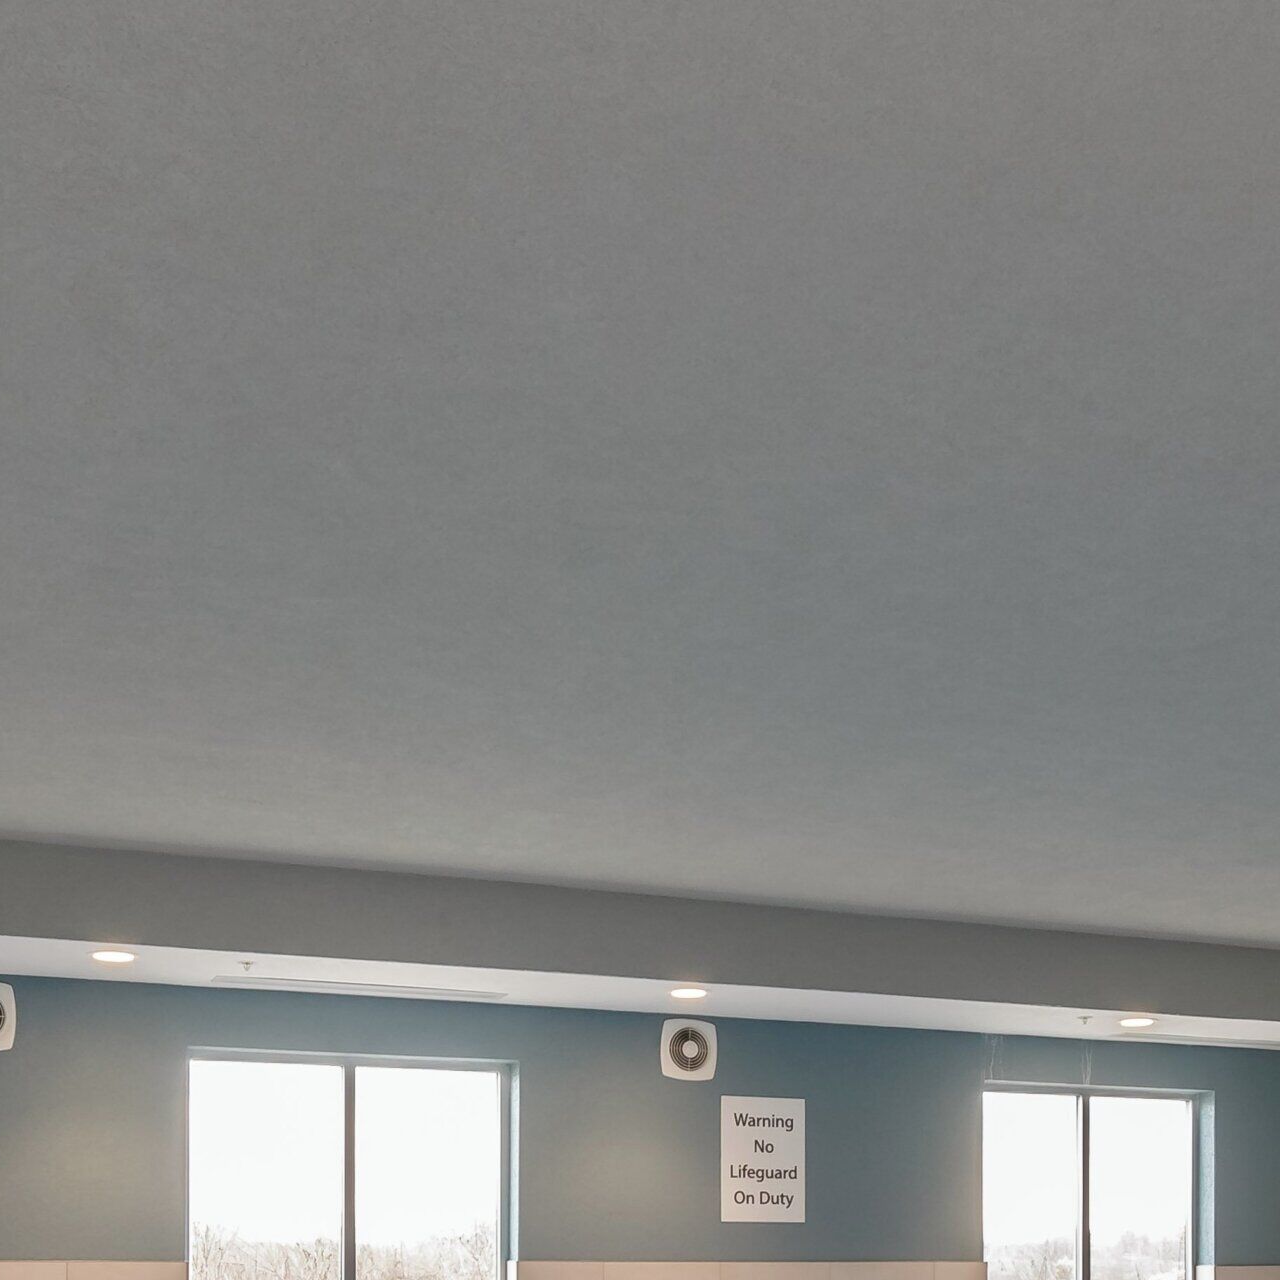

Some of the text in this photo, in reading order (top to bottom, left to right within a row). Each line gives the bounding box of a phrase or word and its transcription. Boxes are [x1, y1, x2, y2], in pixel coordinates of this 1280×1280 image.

[734, 1112, 794, 1132] Warning
[754, 1139, 774, 1153] No
[730, 1164, 798, 1183] Lifeguard
[734, 1190, 794, 1209] On Duty
